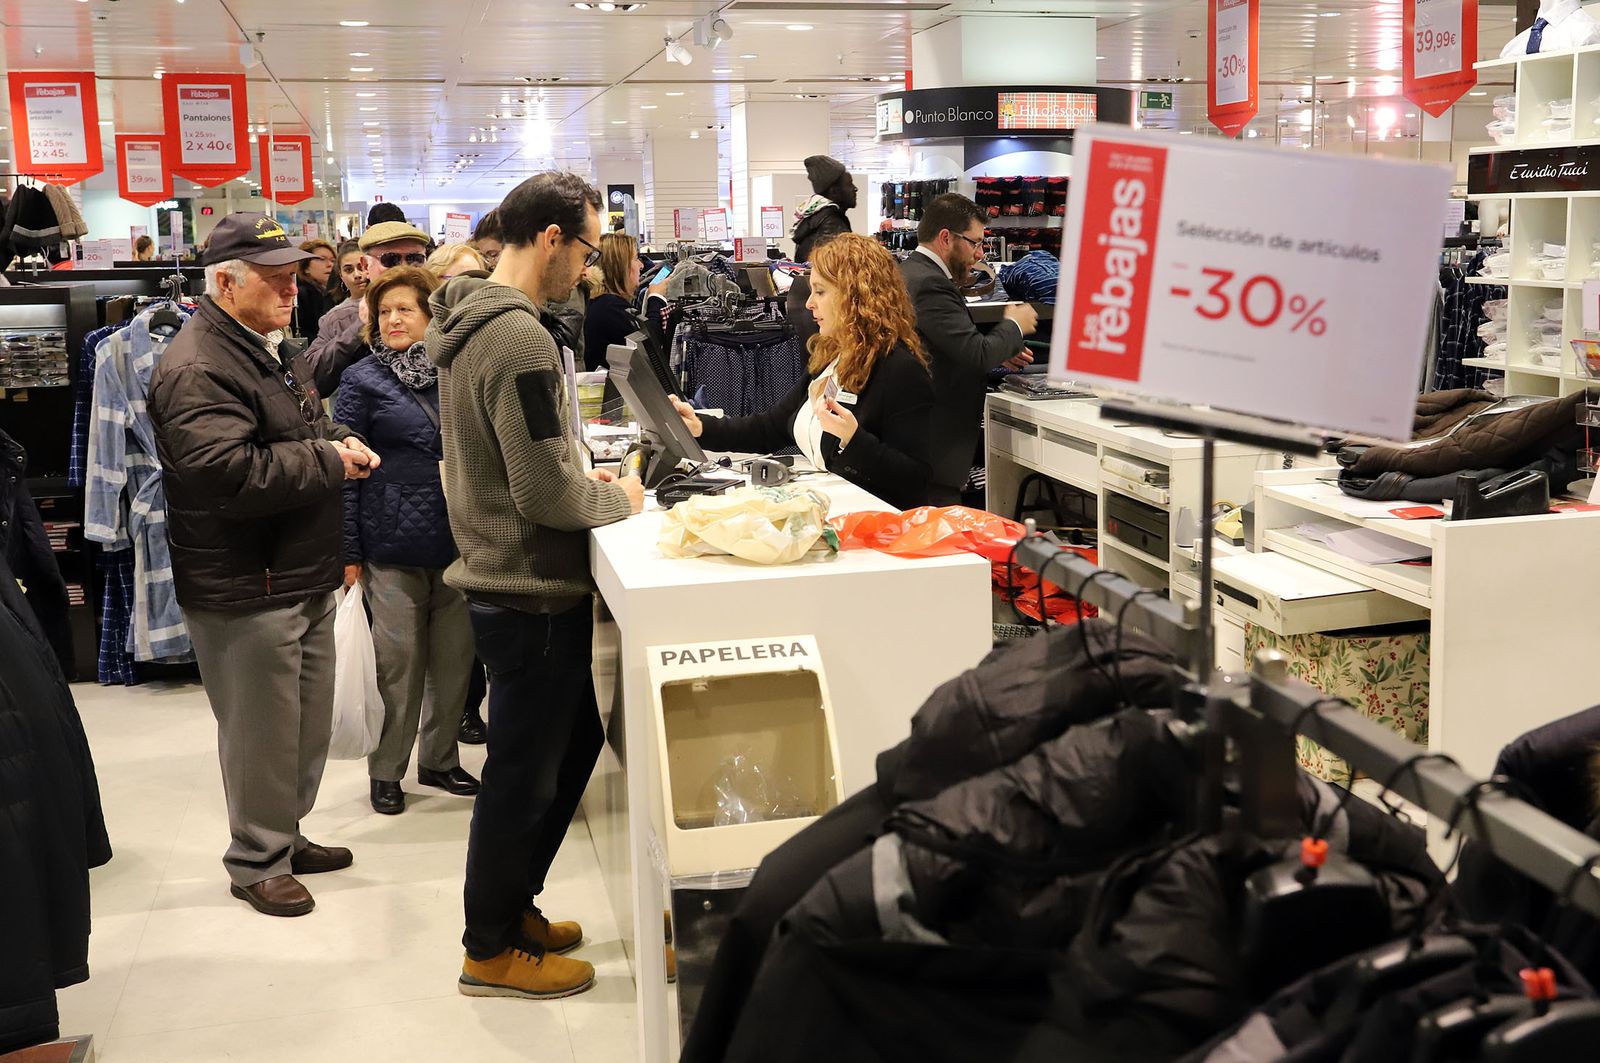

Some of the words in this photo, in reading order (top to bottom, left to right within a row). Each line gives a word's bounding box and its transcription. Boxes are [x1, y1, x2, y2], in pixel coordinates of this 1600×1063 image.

[1416, 29, 1457, 53] 39,99€
[1217, 54, 1246, 78] -30%
[183, 113, 232, 122] Pantalones
[915, 109, 946, 124] Punto
[947, 106, 994, 122] Blanco
[33, 149, 40, 158] 2
[185, 140, 194, 151] 2
[196, 142, 204, 151] x
[1557, 161, 1590, 179] Tucci
[1176, 219, 1265, 247] Selección
[1268, 233, 1294, 250] de
[1091, 177, 1148, 356] rebajas
[1169, 266, 1328, 338] -30%
[660, 641, 809, 667] PAPELERA
